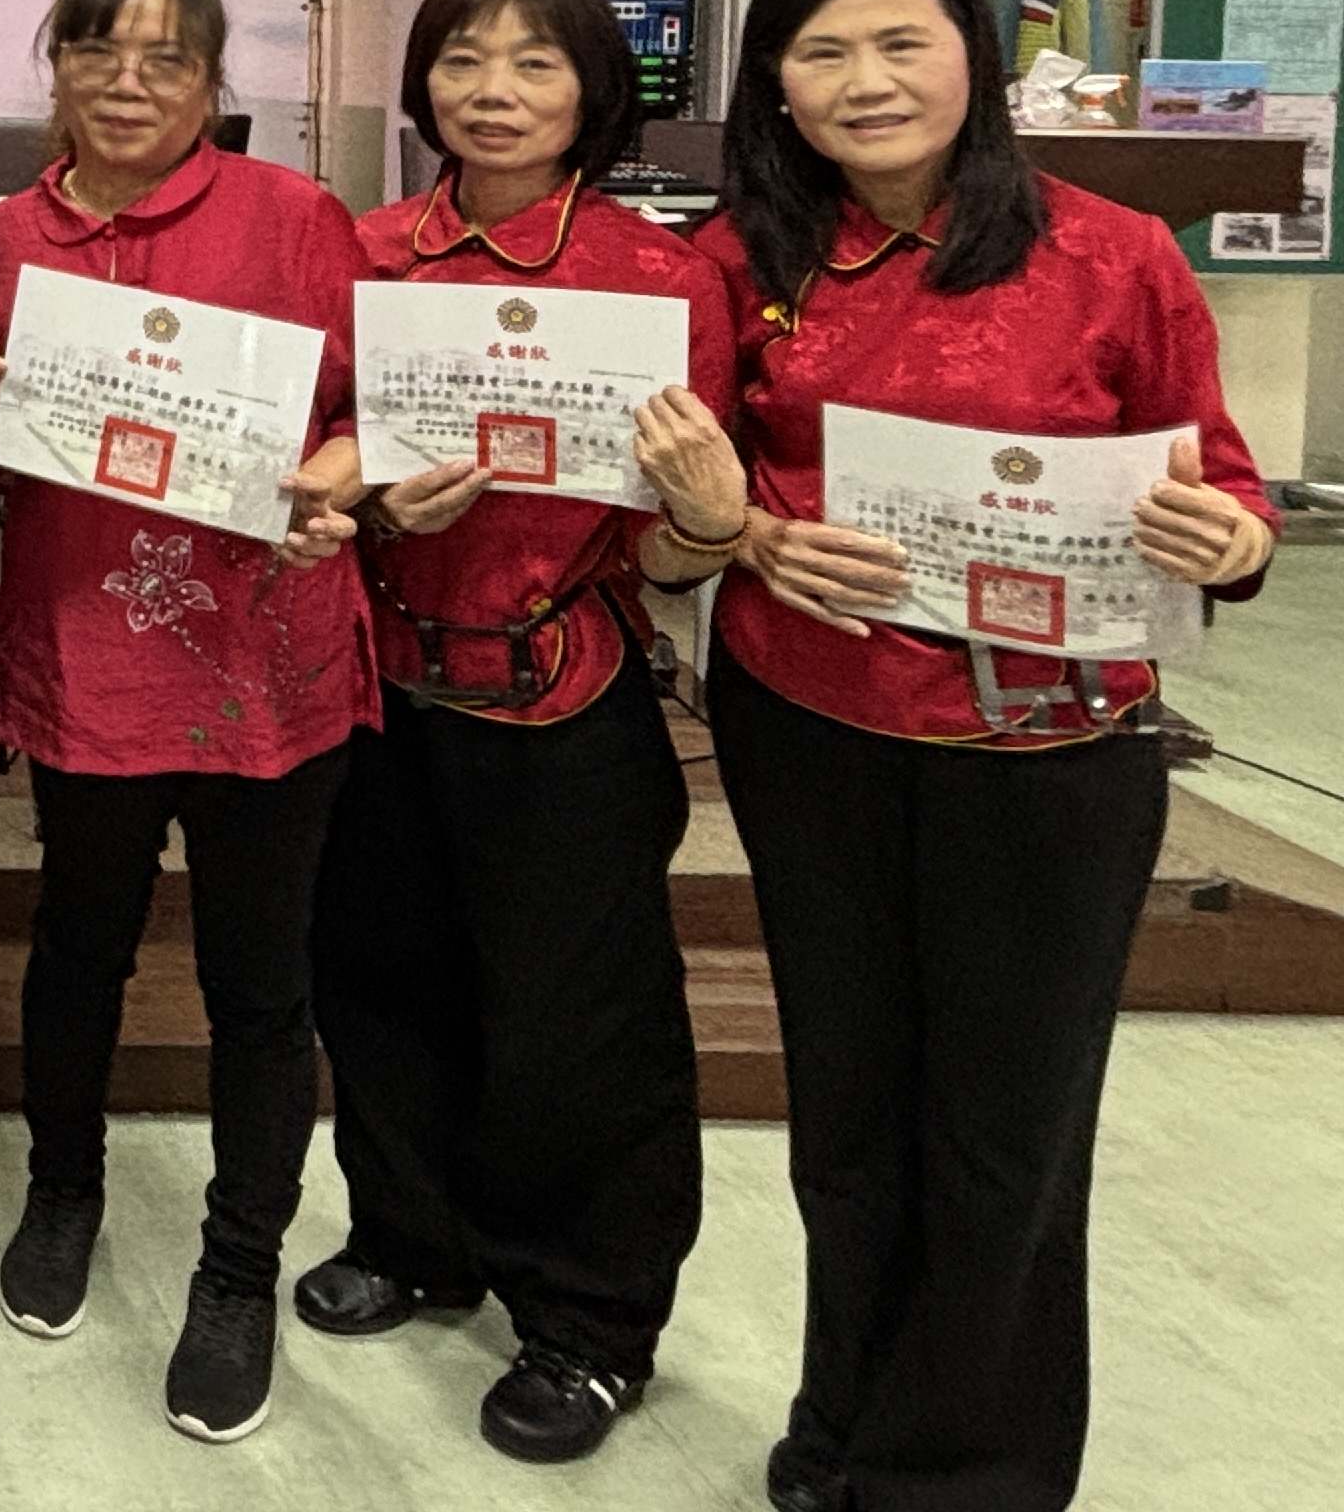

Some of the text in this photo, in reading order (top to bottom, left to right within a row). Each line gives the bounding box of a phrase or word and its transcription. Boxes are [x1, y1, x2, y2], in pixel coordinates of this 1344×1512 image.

[126, 347, 183, 375] 感謝狀
[486, 342, 551, 362] 感謝狀
[979, 491, 1058, 516] 感謝狀
